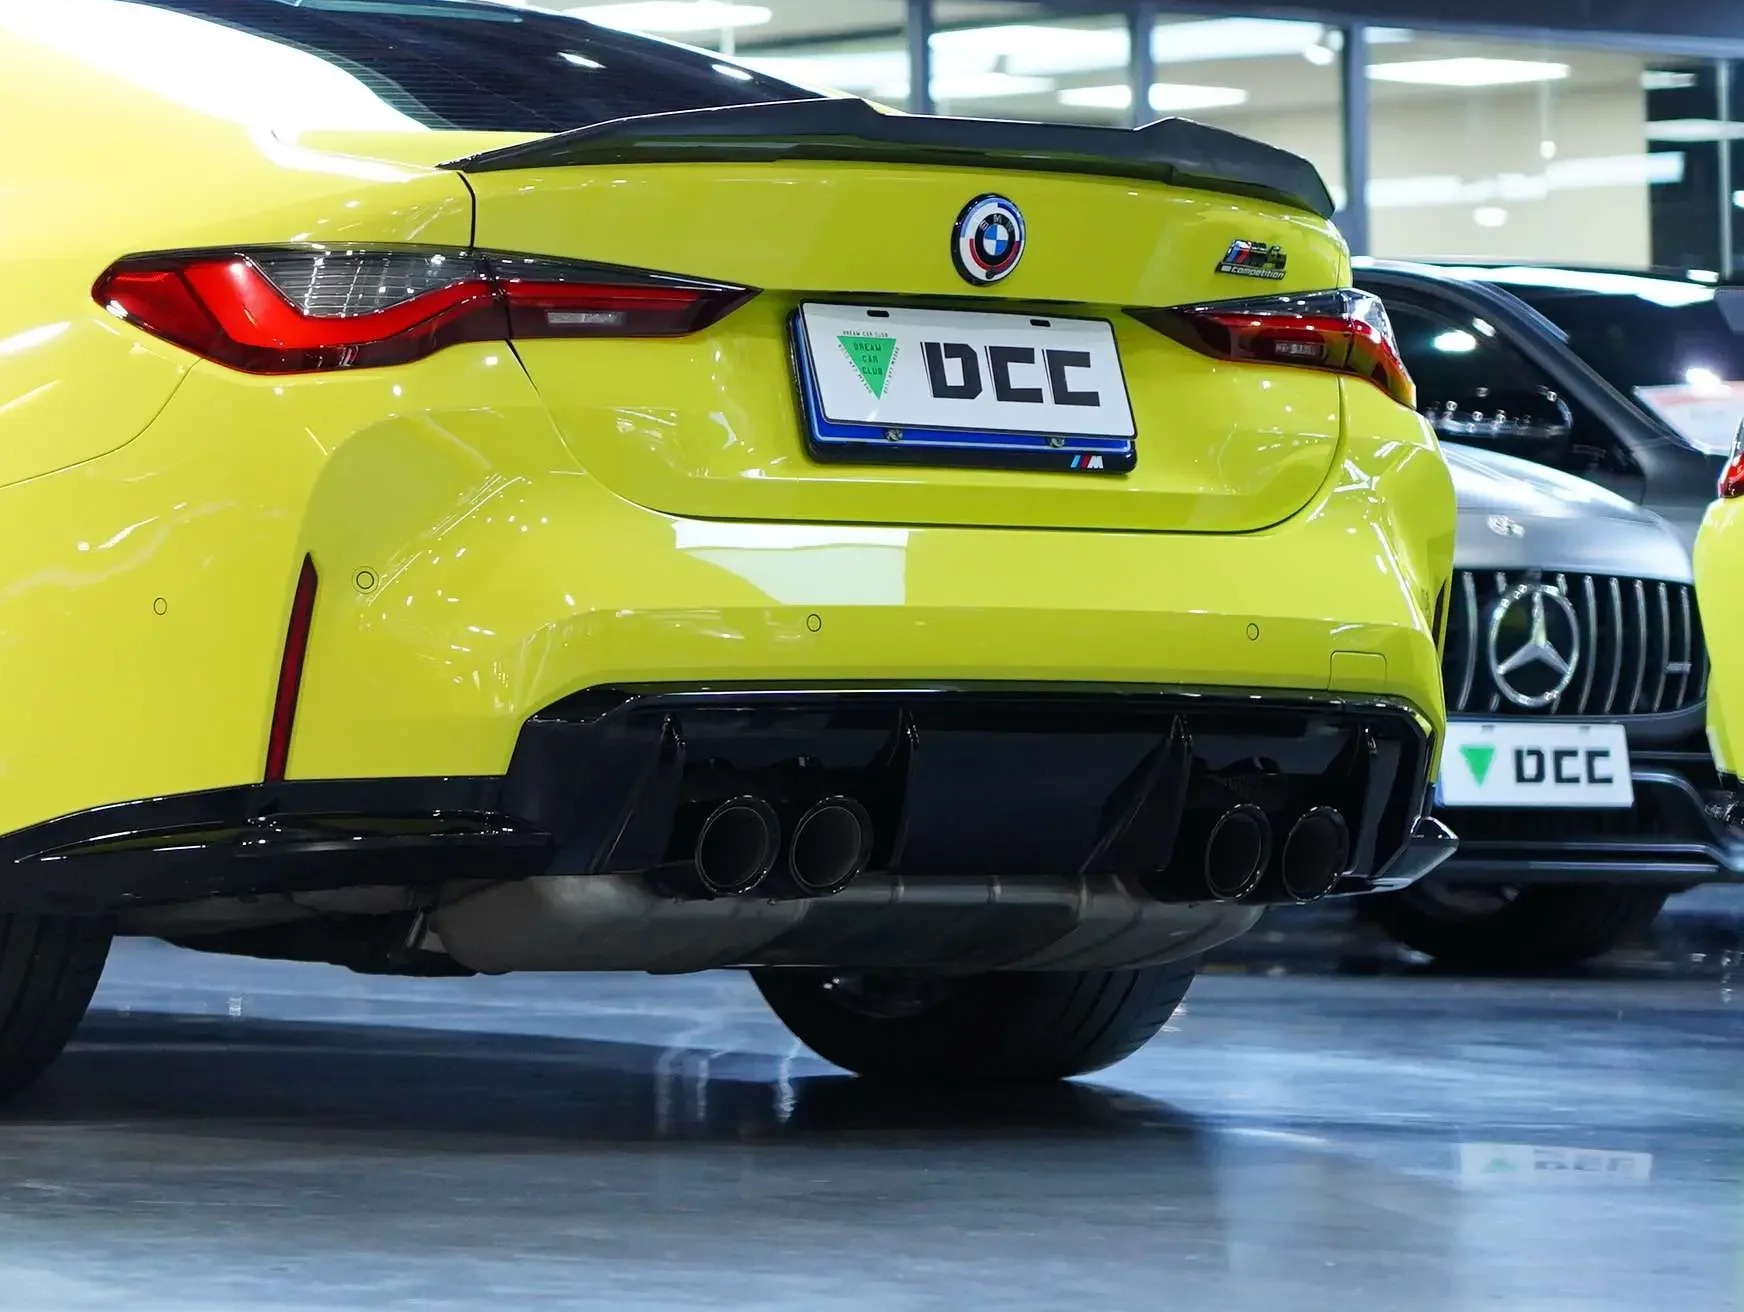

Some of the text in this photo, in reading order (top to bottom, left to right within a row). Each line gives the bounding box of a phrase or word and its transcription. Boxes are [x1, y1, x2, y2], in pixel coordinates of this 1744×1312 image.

[979, 213, 1015, 234] BMW
[919, 341, 1101, 407] DCC
[1513, 748, 1614, 785] DCC
